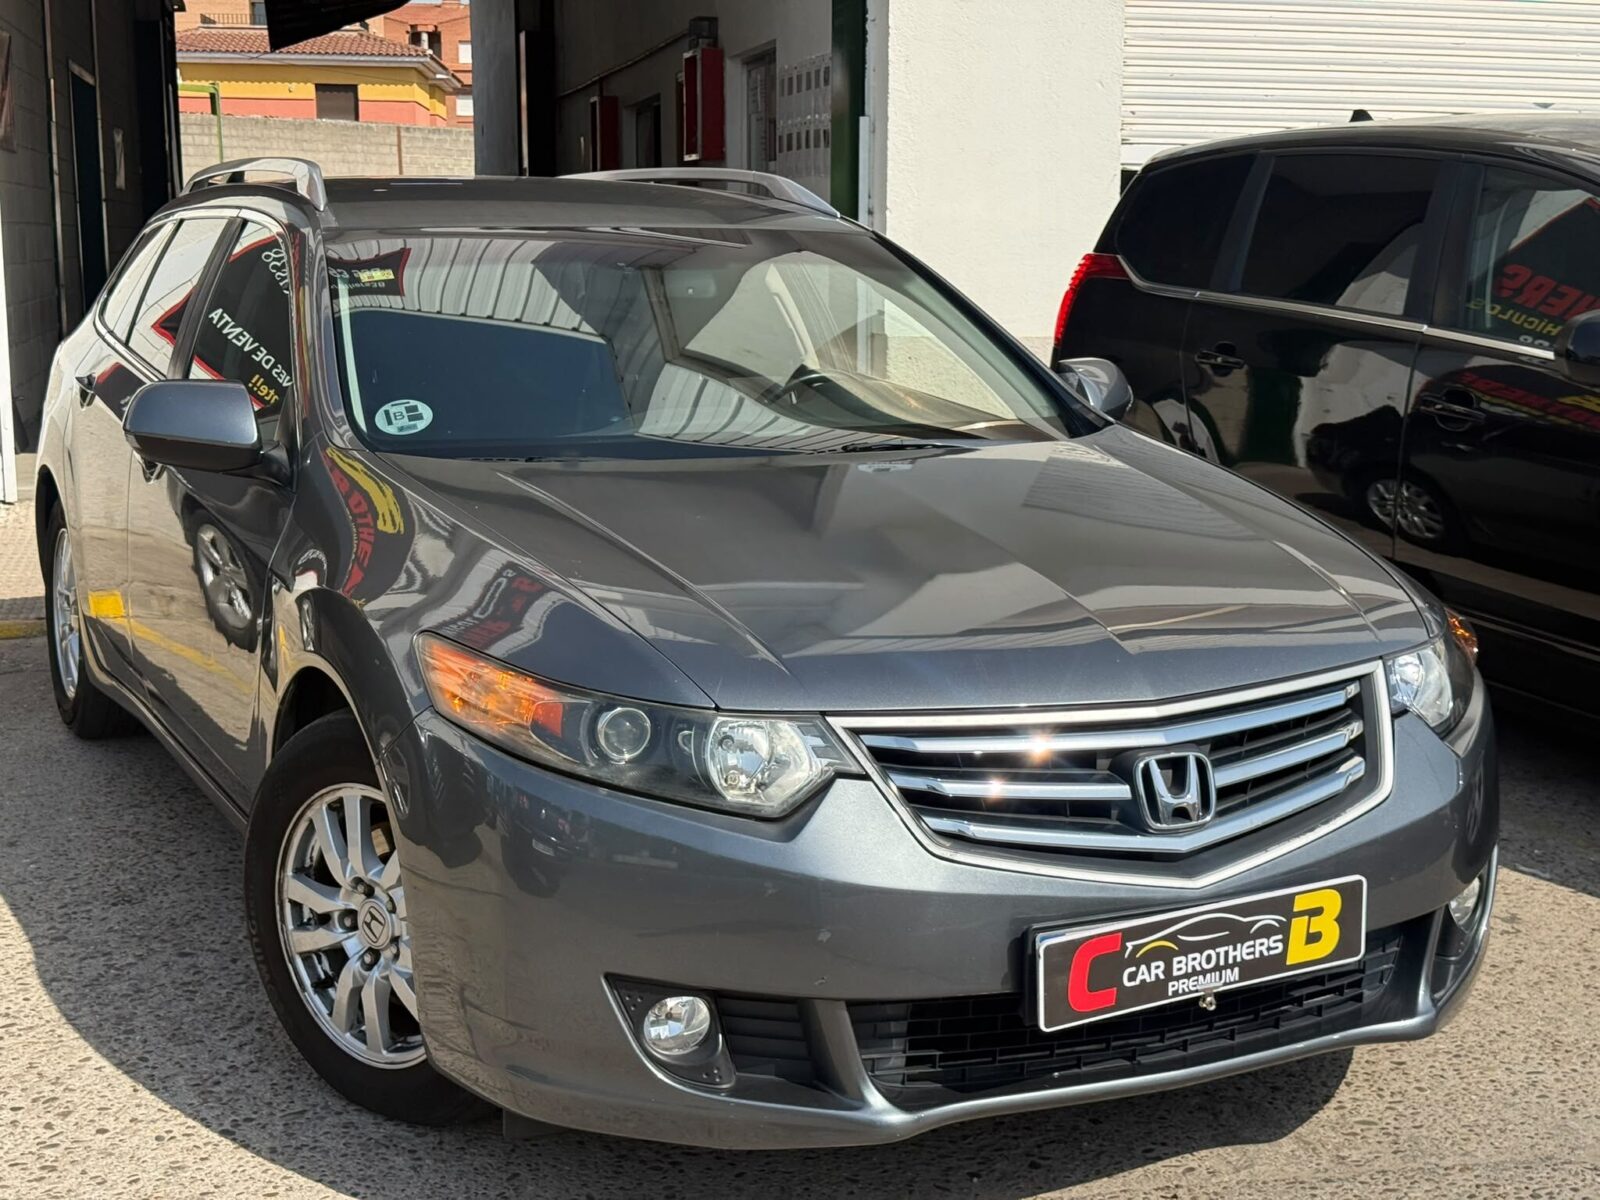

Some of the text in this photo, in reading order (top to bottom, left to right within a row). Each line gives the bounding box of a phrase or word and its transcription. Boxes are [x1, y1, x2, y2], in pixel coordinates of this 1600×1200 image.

[393, 410, 405, 421] B
[1286, 888, 1342, 965] B
[1067, 932, 1122, 1012] C
[1122, 934, 1284, 987] CAR BROTHERS
[1168, 966, 1240, 997] PREMIUM
